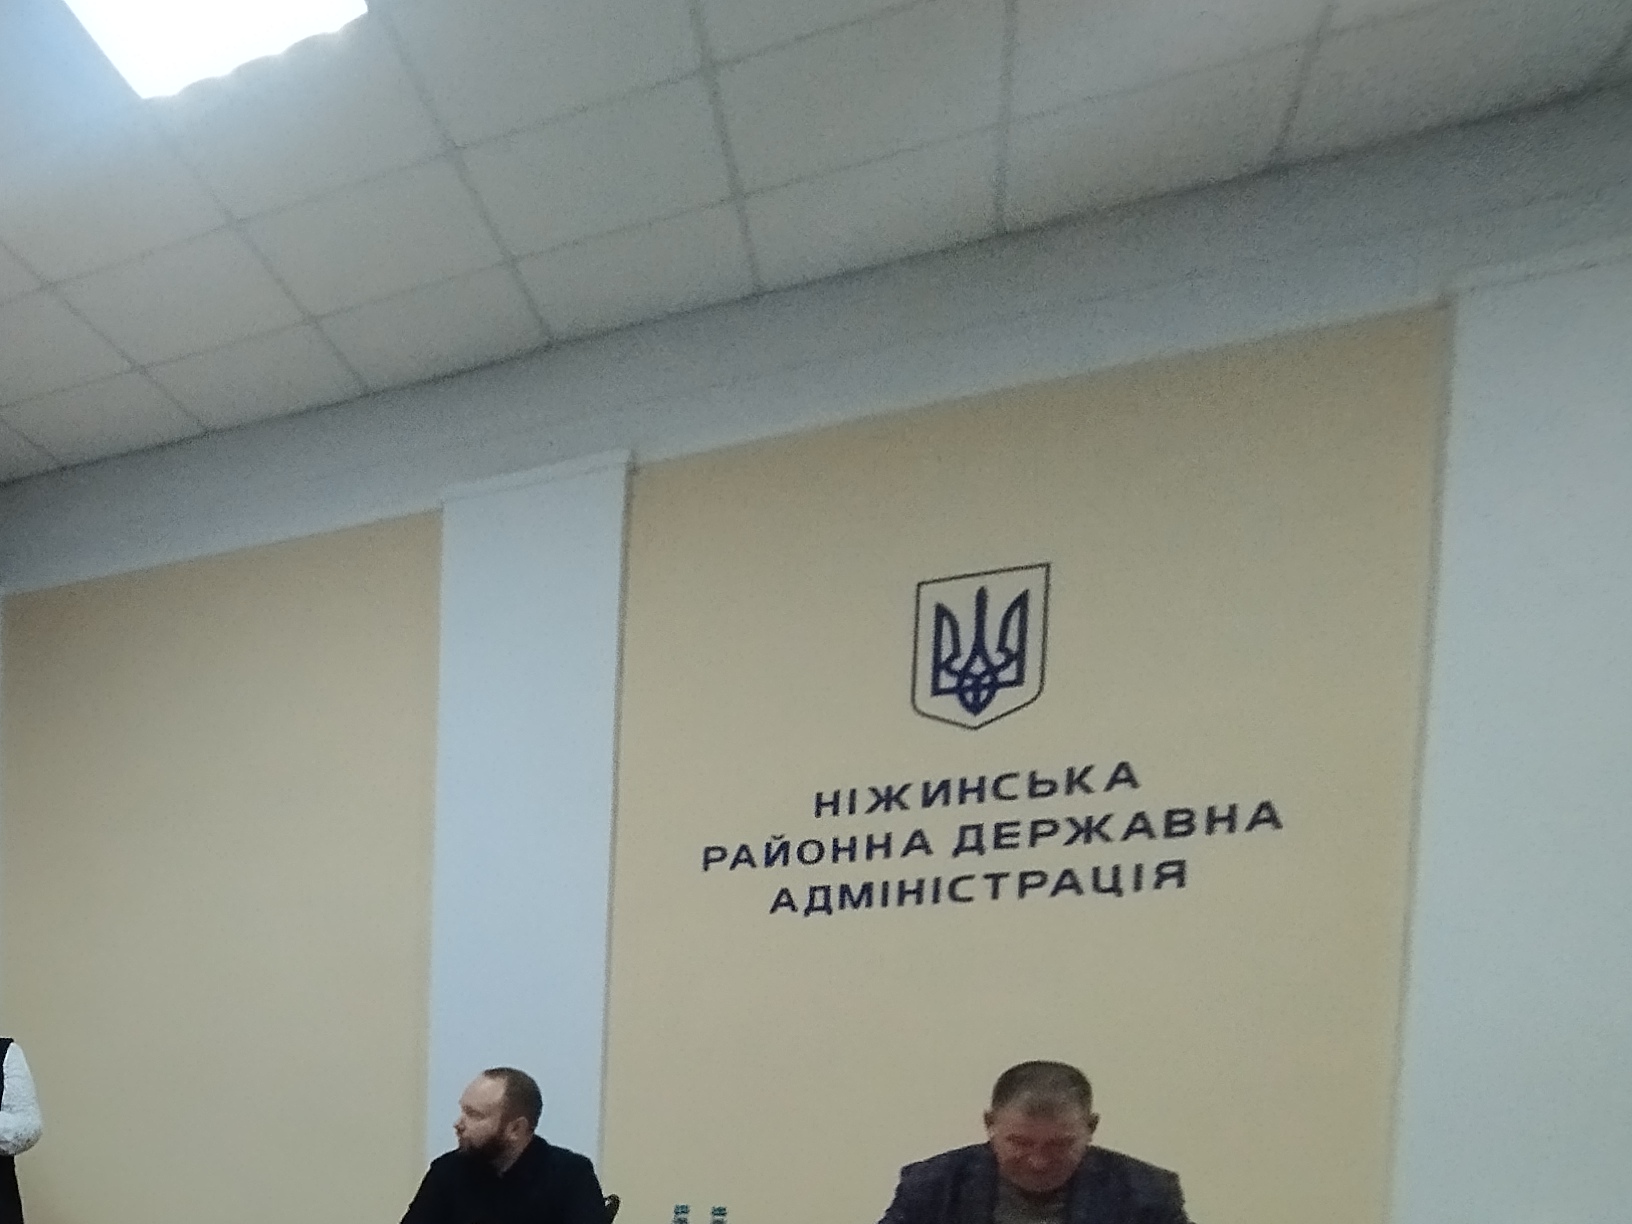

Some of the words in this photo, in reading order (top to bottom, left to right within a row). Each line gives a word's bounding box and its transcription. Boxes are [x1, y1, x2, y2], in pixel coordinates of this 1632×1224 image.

[813, 760, 1141, 819] НІЖИНСЬКА
[702, 828, 934, 873] РАЙОННА
[951, 800, 1284, 859] ДЕРЖАВНА
[768, 859, 1187, 918] АДМІНІСТРАЦІЯ
